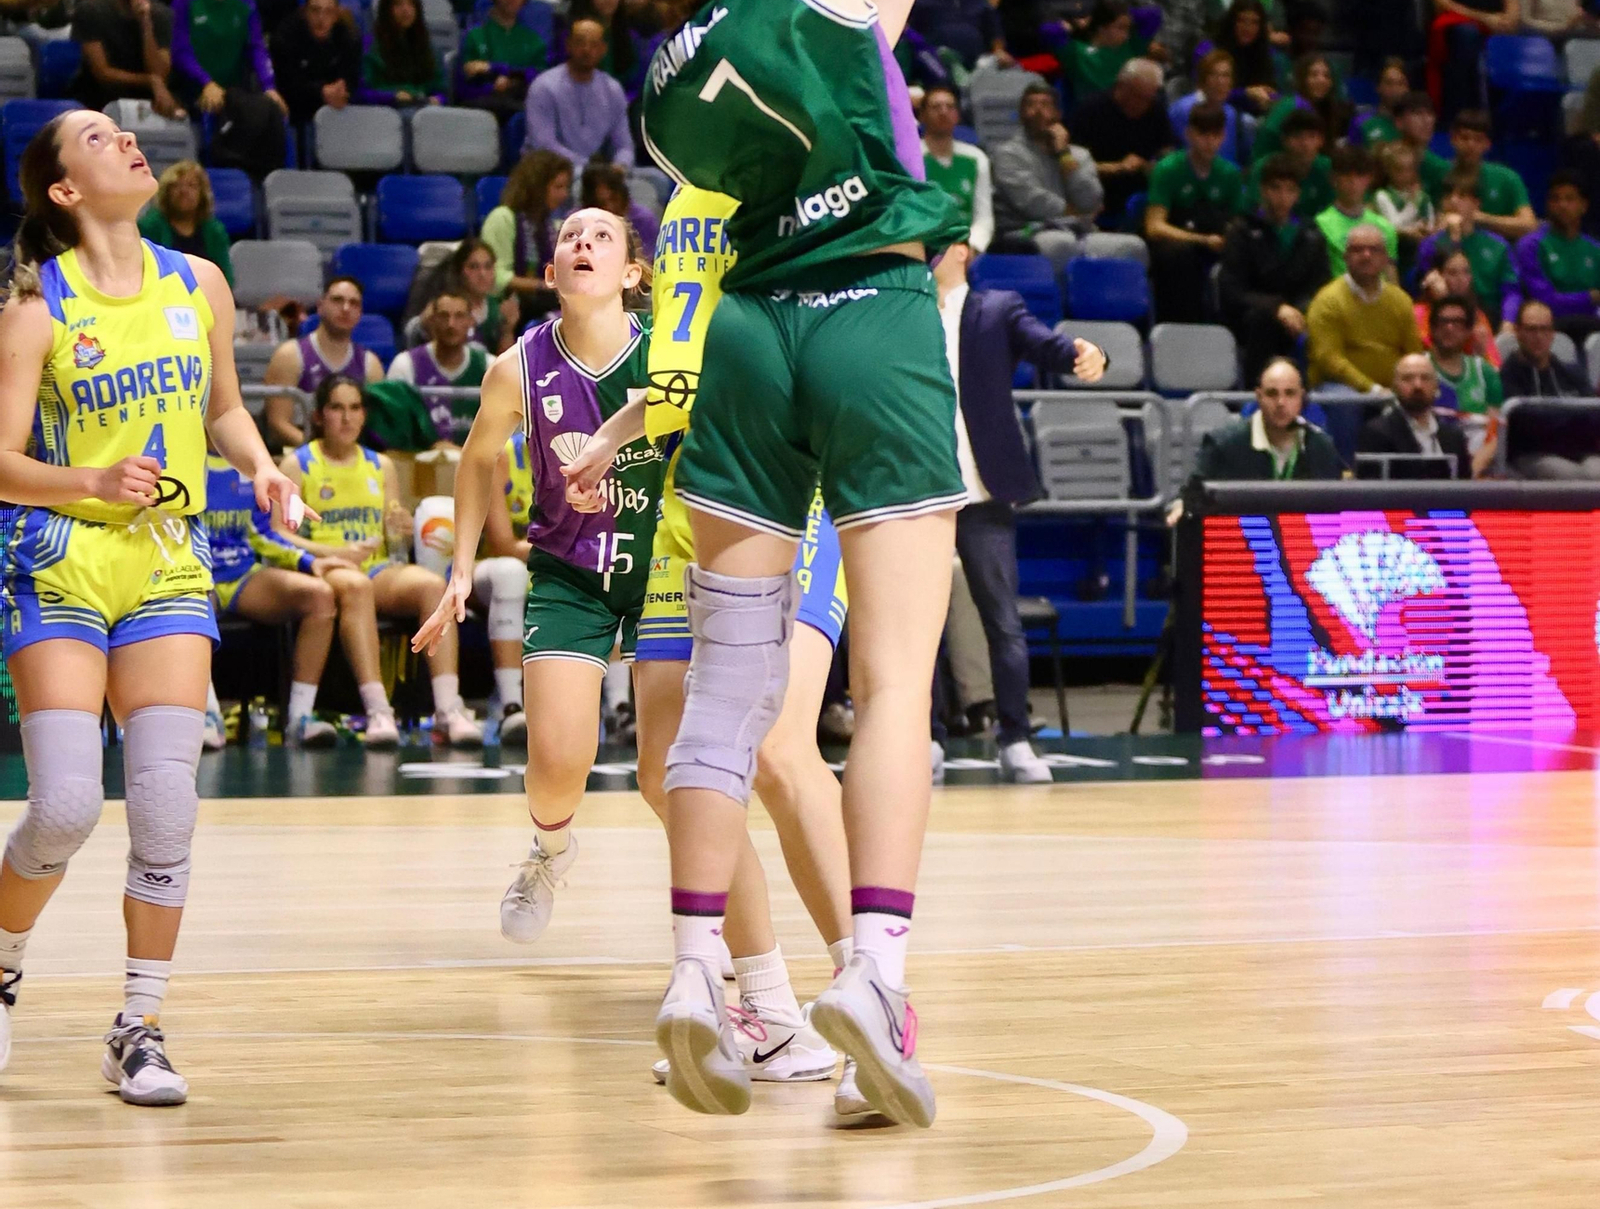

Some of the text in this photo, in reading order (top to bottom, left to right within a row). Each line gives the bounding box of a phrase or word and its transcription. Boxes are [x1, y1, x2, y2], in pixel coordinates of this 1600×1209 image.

[698, 56, 812, 152] 7
[672, 281, 703, 343] 7
[75, 394, 198, 434] TENERIF
[141, 422, 168, 470] 4
[596, 530, 635, 592] 15
